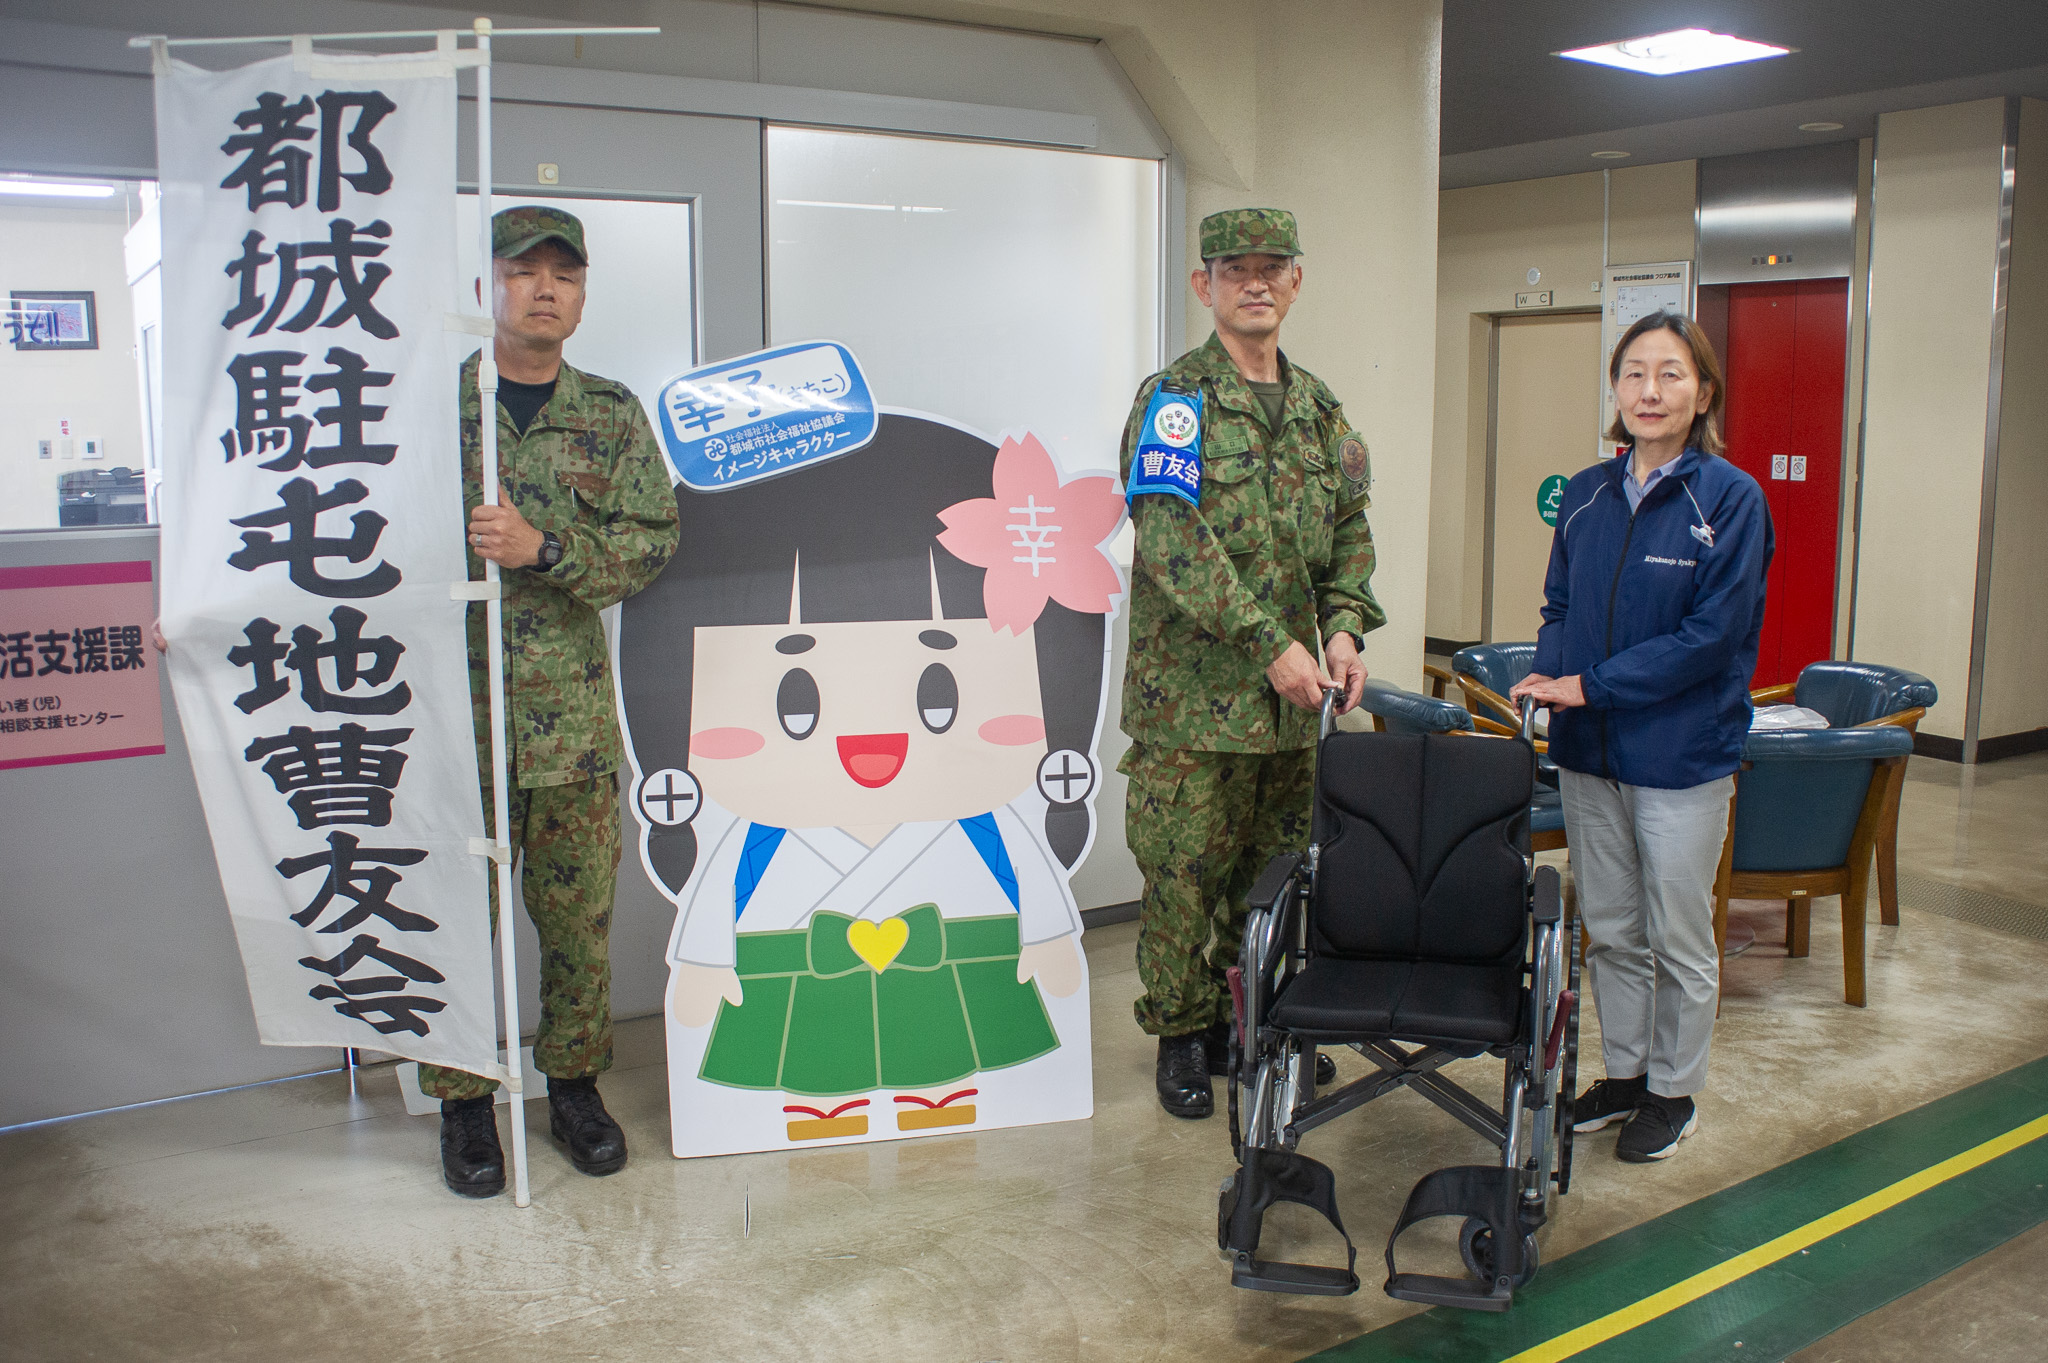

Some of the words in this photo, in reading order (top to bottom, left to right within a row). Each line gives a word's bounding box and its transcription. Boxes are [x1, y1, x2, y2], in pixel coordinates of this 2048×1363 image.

[725, 421, 779, 444] 社会福祉法人
[729, 412, 846, 456] 都城市社会福祉協議会
[713, 431, 851, 481] イメージキャラクター
[1141, 451, 1200, 489] 曹友会
[221, 90, 448, 1038] 都城駐屯地曹友会
[0, 625, 146, 679] 活支援課
[0, 711, 125, 733] 相談支援センター
